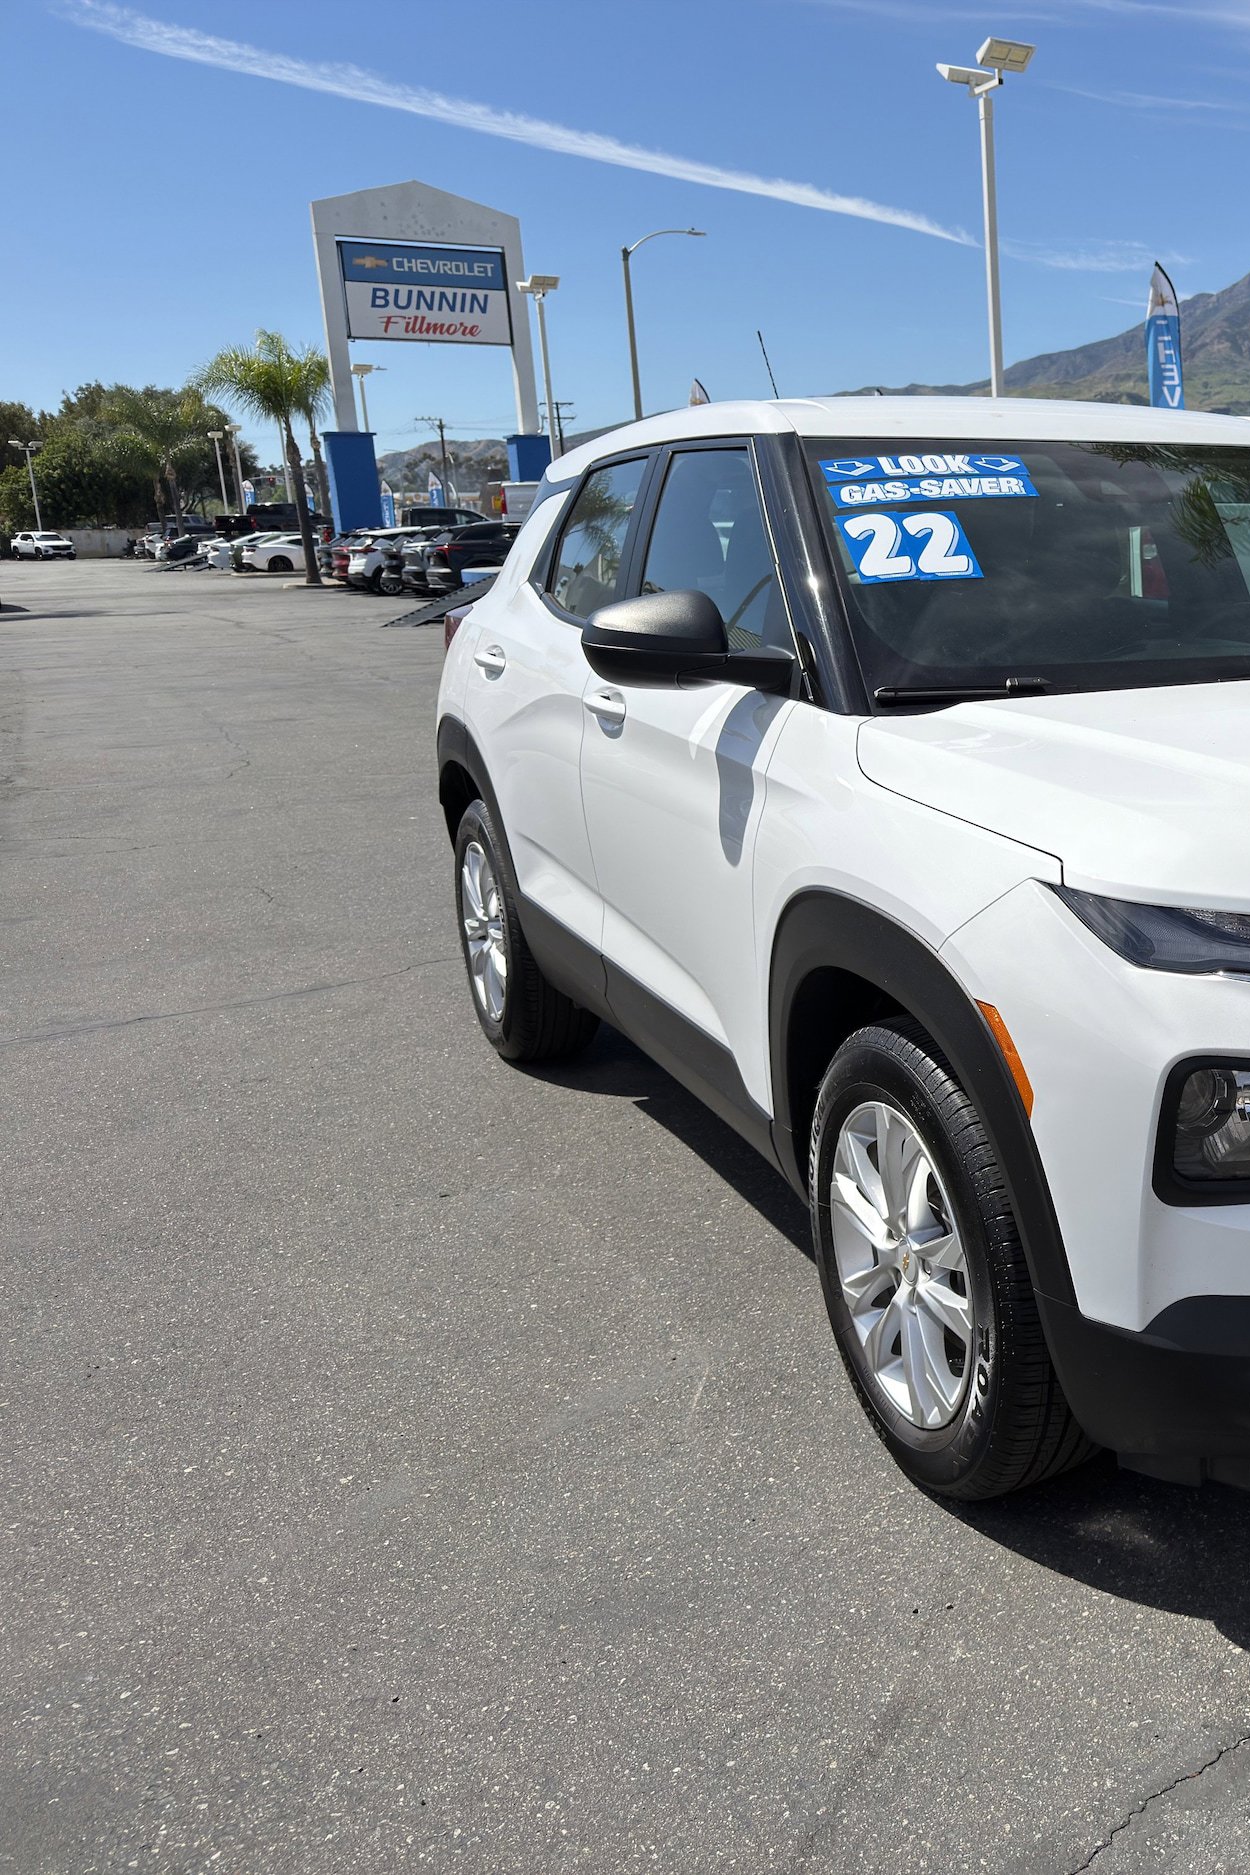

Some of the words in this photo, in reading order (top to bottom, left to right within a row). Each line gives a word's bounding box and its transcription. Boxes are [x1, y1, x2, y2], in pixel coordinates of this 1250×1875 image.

[392, 257, 494, 277] CHEVROLET
[371, 287, 489, 314] BUNNIN
[378, 315, 482, 337] Fillmore
[877, 454, 979, 476] LOOK
[840, 477, 1027, 504] GAS-SAVER
[843, 513, 975, 580] 22
